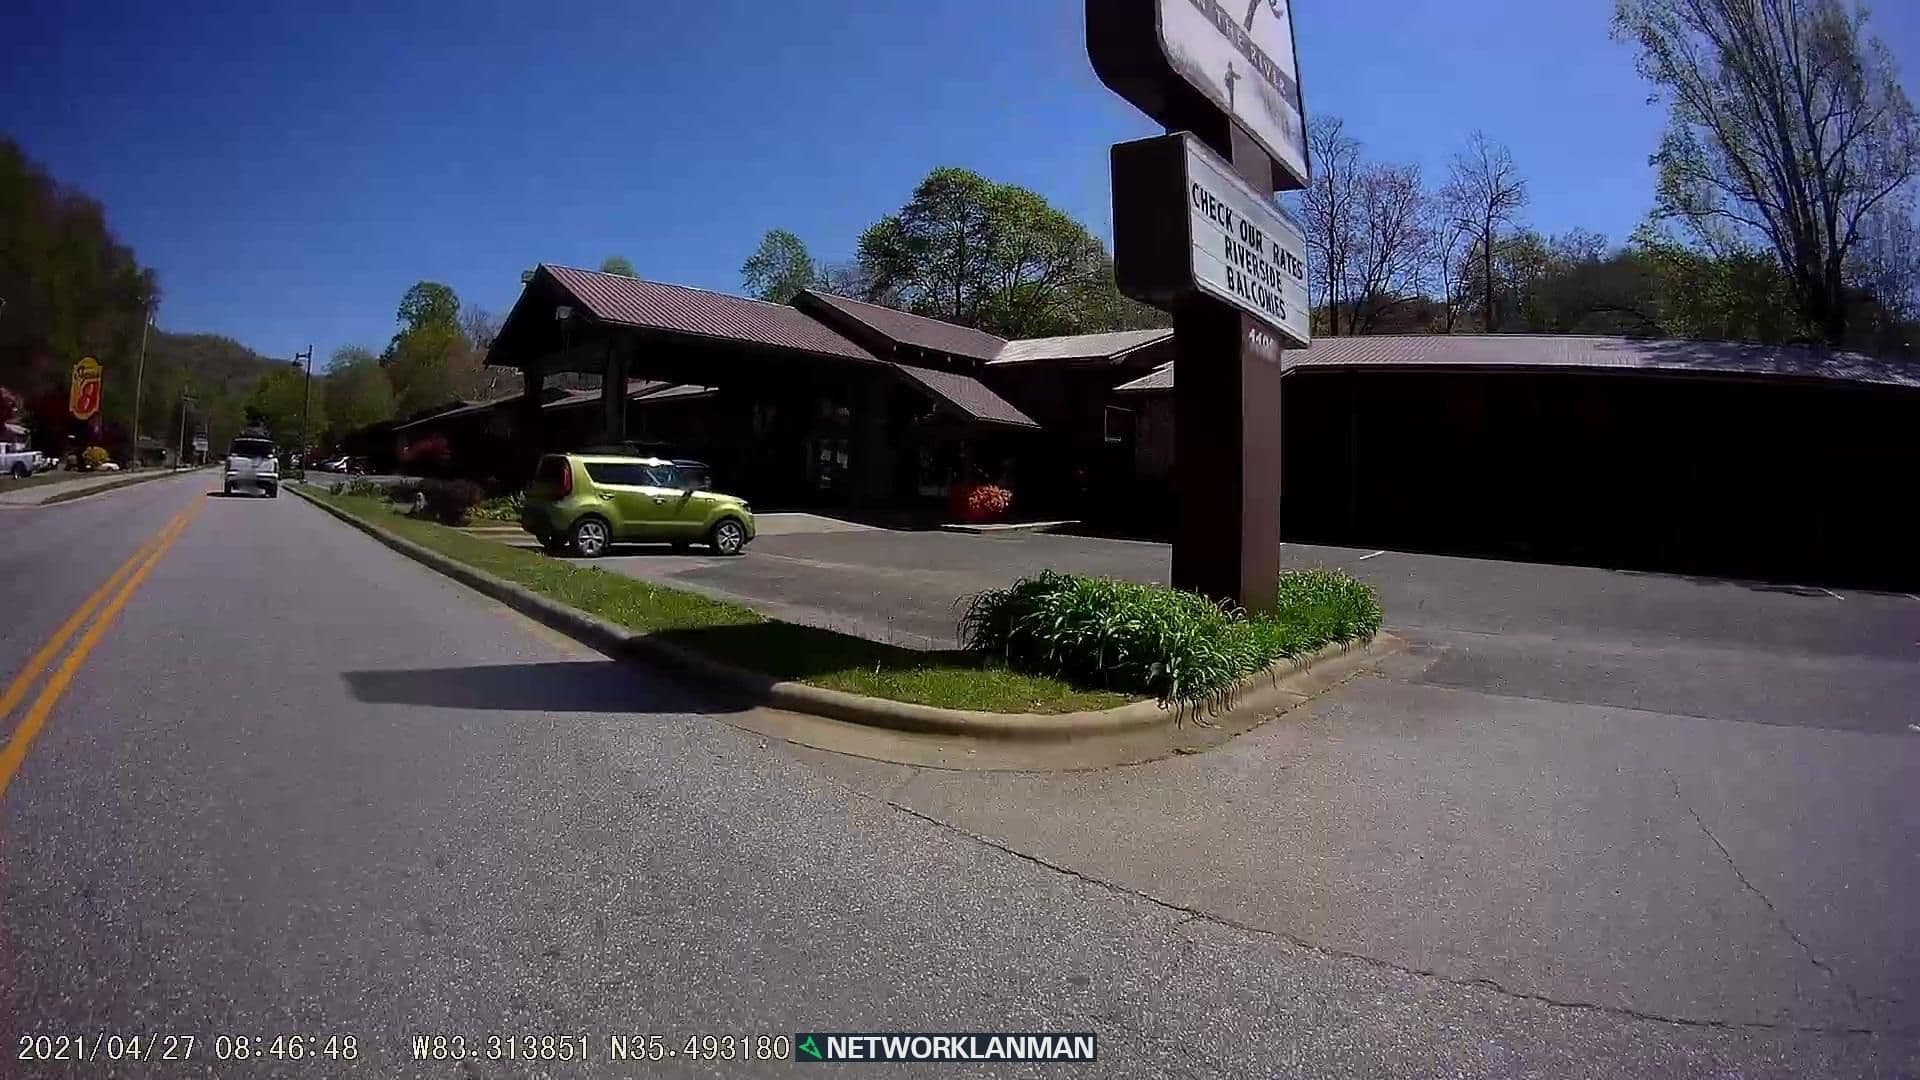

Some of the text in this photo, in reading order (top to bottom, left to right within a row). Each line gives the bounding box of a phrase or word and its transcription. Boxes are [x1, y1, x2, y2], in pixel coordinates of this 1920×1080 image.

[1215, 7, 1245, 49] THE
[1191, 182, 1304, 280] CHECK OUR RATES
[1224, 235, 1283, 293] RIVERSIDE
[1226, 265, 1287, 320] BALCONIES
